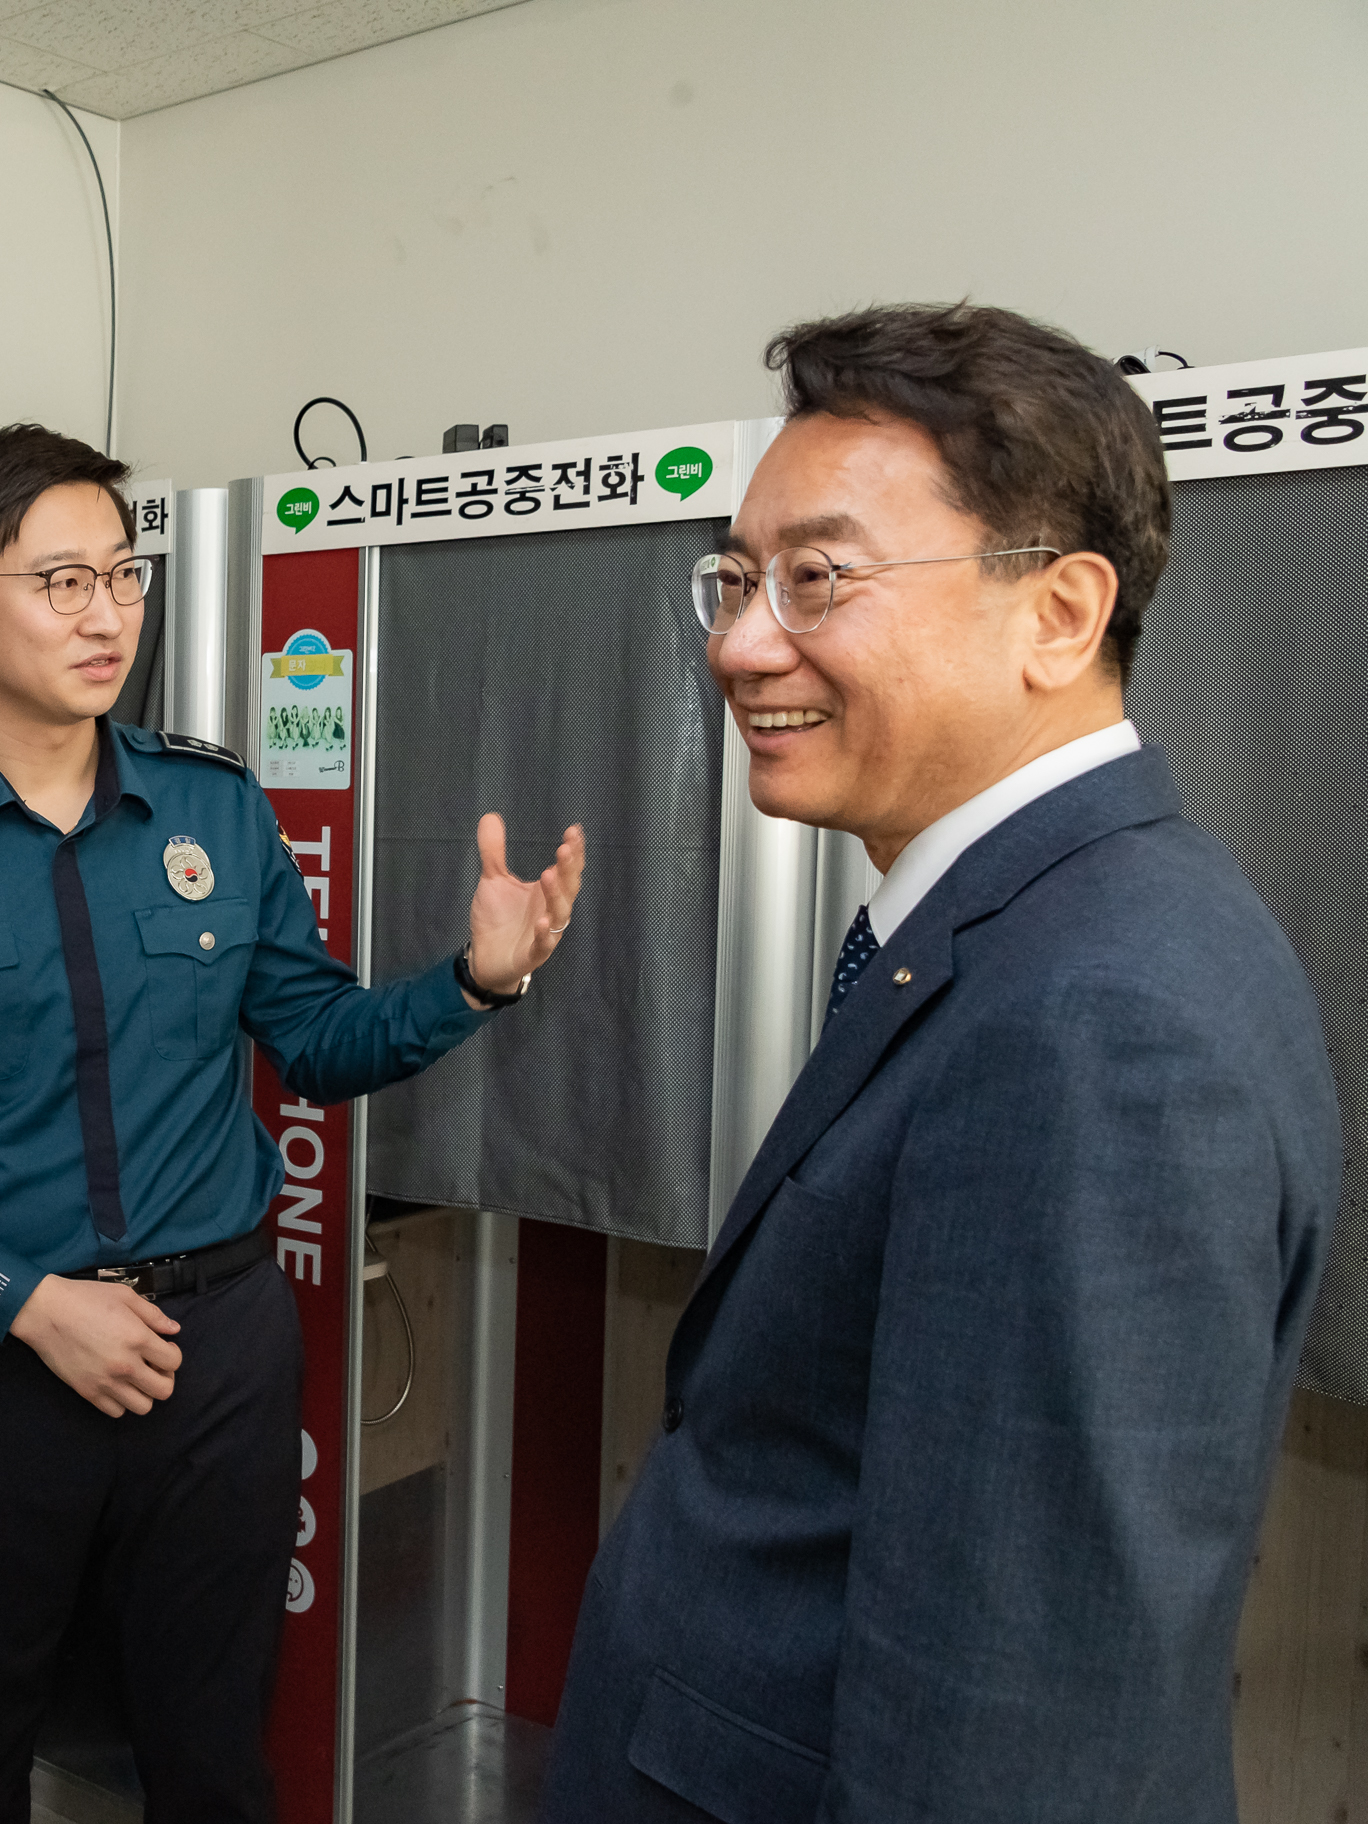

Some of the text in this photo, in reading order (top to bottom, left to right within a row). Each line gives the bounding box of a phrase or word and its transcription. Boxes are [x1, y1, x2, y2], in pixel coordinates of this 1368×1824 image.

[285, 452, 702, 526] 그린비 스마트공중전화 그린비
